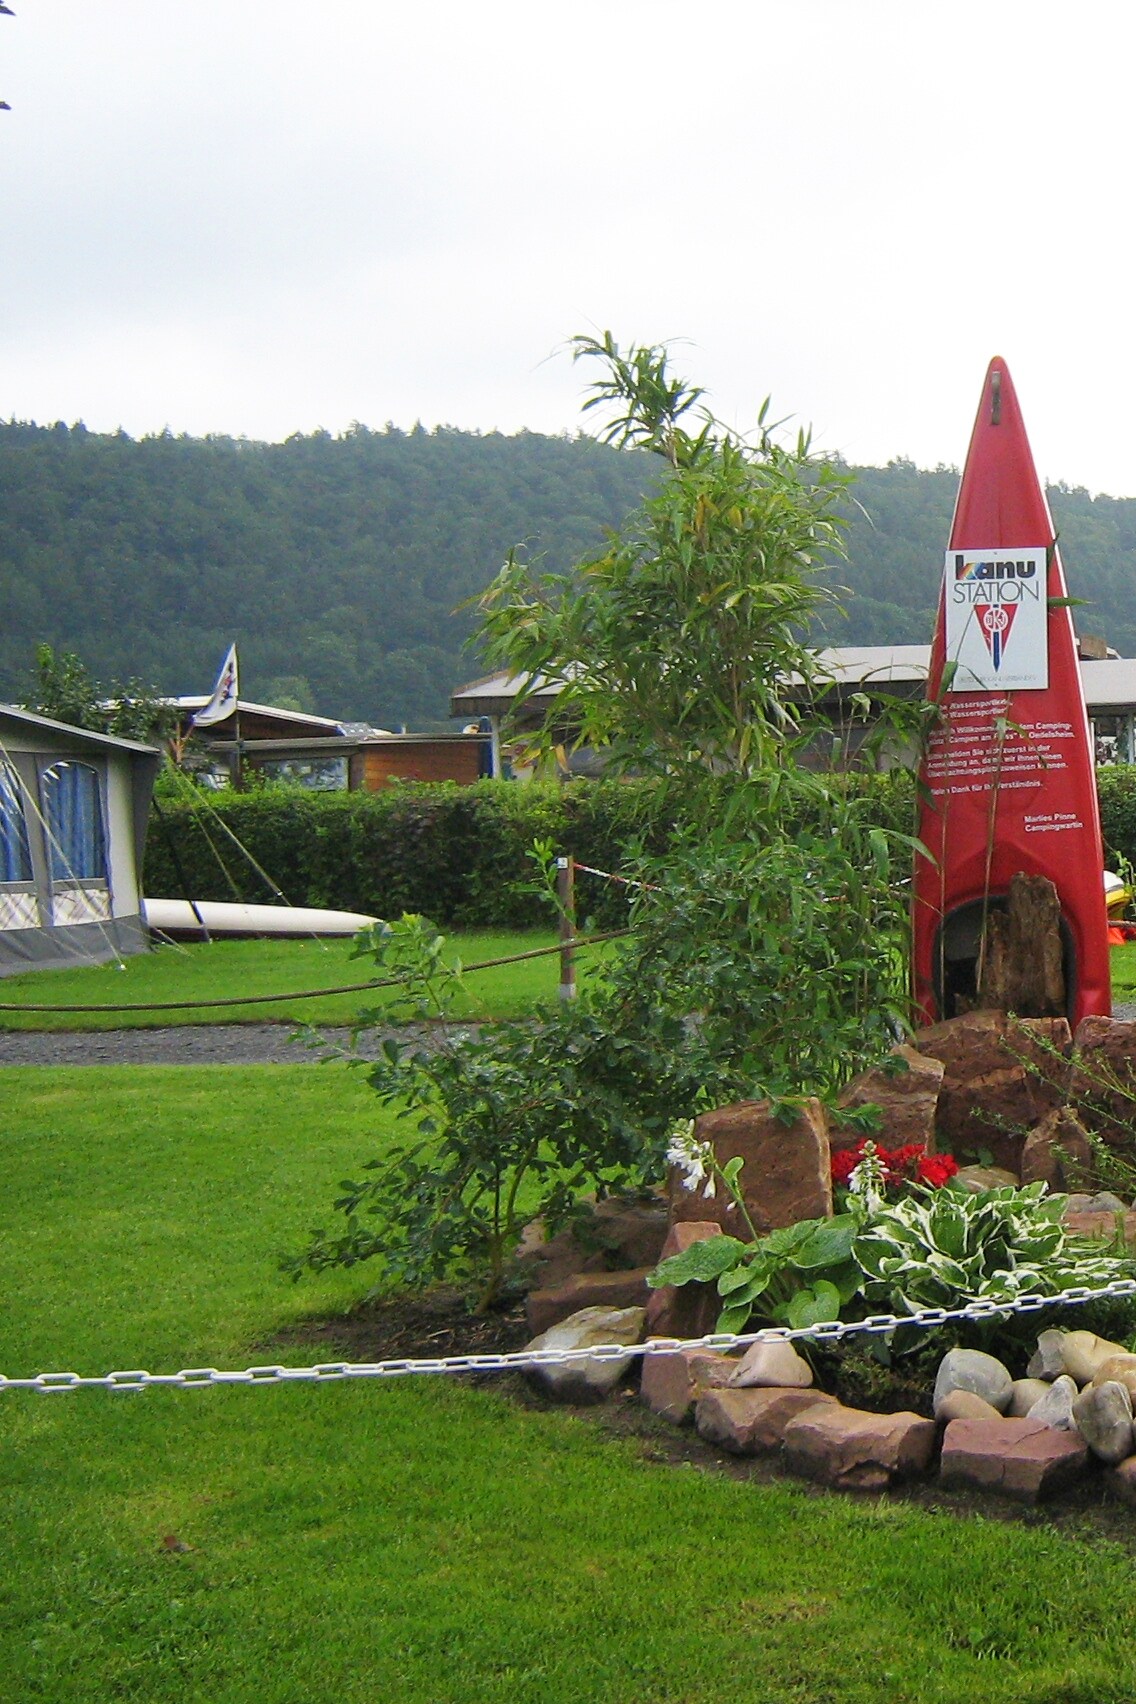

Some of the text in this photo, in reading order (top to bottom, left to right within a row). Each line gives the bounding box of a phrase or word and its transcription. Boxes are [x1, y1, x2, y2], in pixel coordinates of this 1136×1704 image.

[955, 555, 1035, 579] kanu
[953, 581, 1040, 603] STATION
[957, 725, 995, 733] Willkomm
[1036, 722, 1072, 730] Camping-
